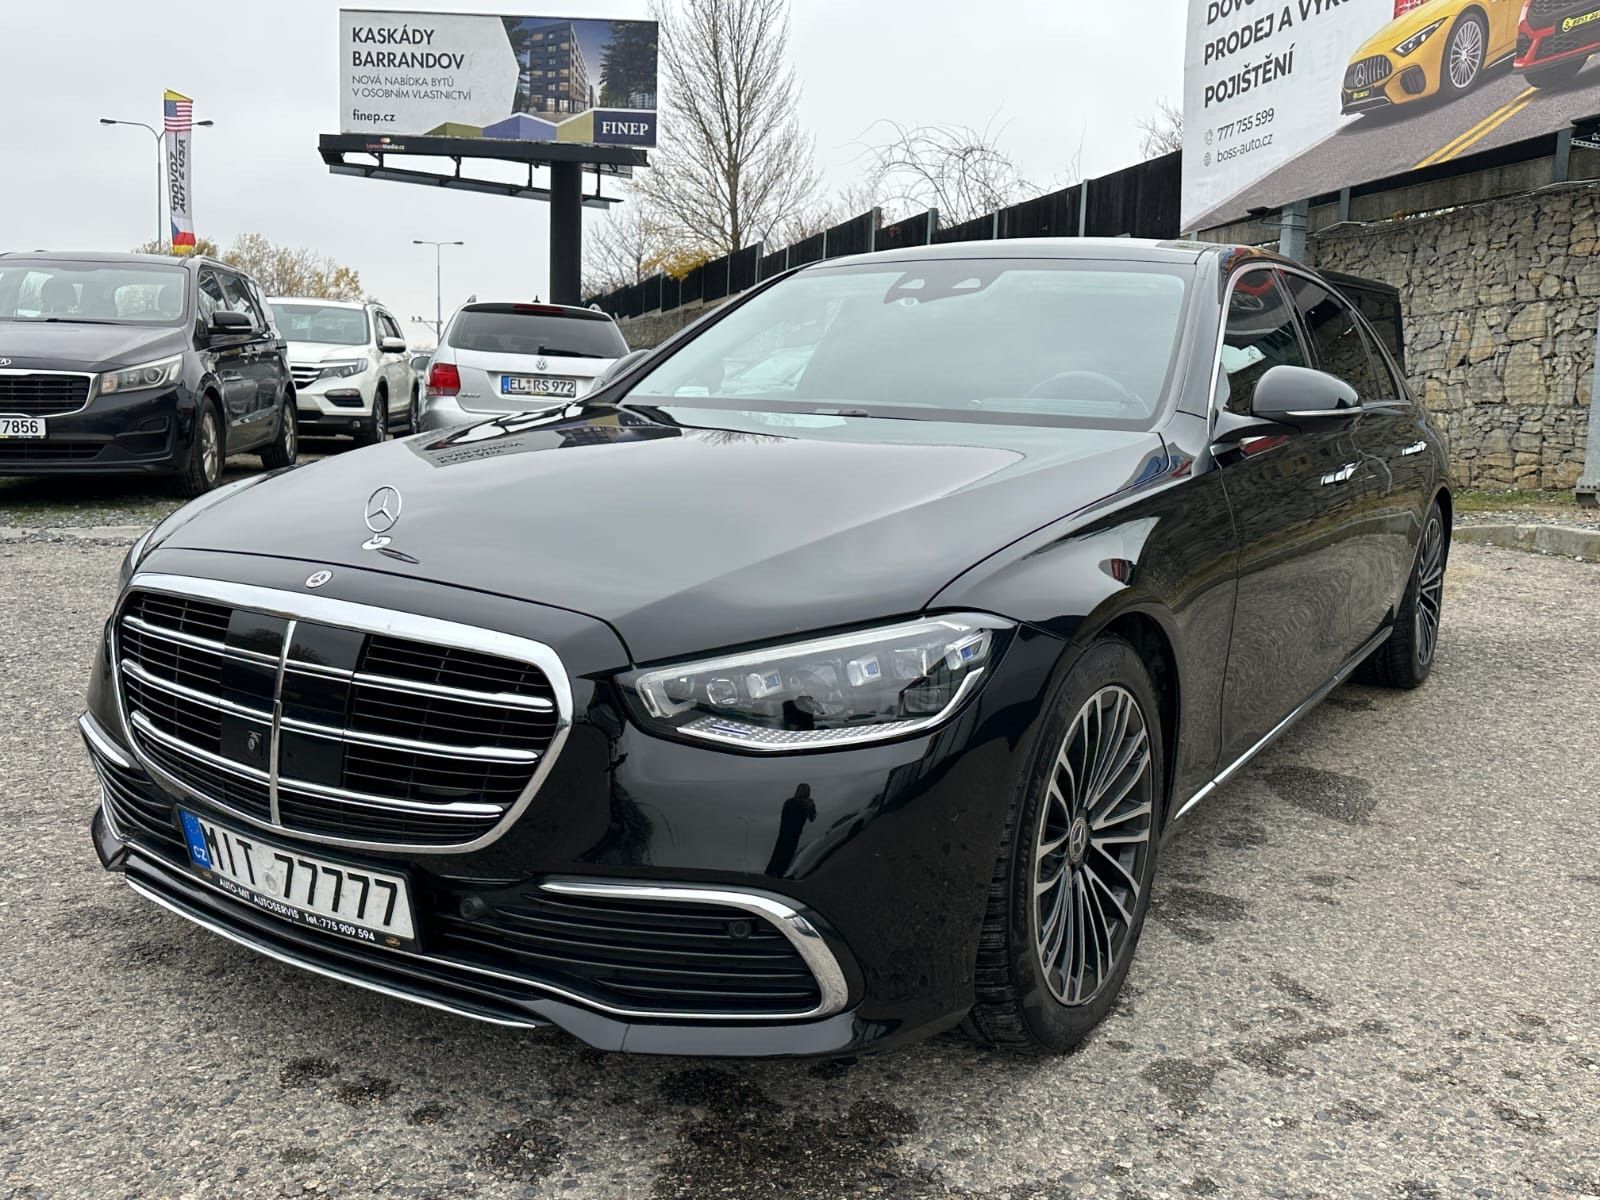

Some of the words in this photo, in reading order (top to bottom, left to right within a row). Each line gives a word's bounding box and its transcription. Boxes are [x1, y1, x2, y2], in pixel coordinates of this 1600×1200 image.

[352, 24, 435, 45] KASKÁDY
[1204, 12, 1275, 65] PRODEJ
[1278, 6, 1293, 32] A
[352, 51, 465, 70] BARRANDOV
[352, 74, 382, 85] NOVÁ
[384, 75, 429, 87] NABÍDKA
[431, 75, 454, 87] BYTŮ
[1204, 43, 1296, 108] POJIŠTĚNÍ
[352, 88, 359, 96] V
[361, 87, 409, 98] OSOBNÍM
[412, 89, 471, 101] VLASTNICTVÍ
[353, 109, 396, 124] finep.cz
[602, 121, 649, 136] FINEP
[1217, 122, 1235, 142] 777
[1236, 115, 1253, 134] 755
[1255, 107, 1274, 127] 599
[178, 139, 186, 169] USA
[1217, 133, 1273, 163] boss-auto.cz
[170, 152, 180, 208] DOVOZ
[178, 182, 186, 213] AUT
[510, 378, 526, 391] EL
[534, 379, 549, 392] RS
[552, 381, 574, 393] 972
[2, 420, 39, 434] 7856
[193, 845, 208, 862] CZ
[200, 822, 256, 885] MIT
[274, 853, 398, 927] 77777
[219, 877, 251, 900] AUTO-MIT
[253, 895, 300, 919] AUTOSERVIS
[338, 923, 356, 936] 909
[357, 928, 376, 942] 594
